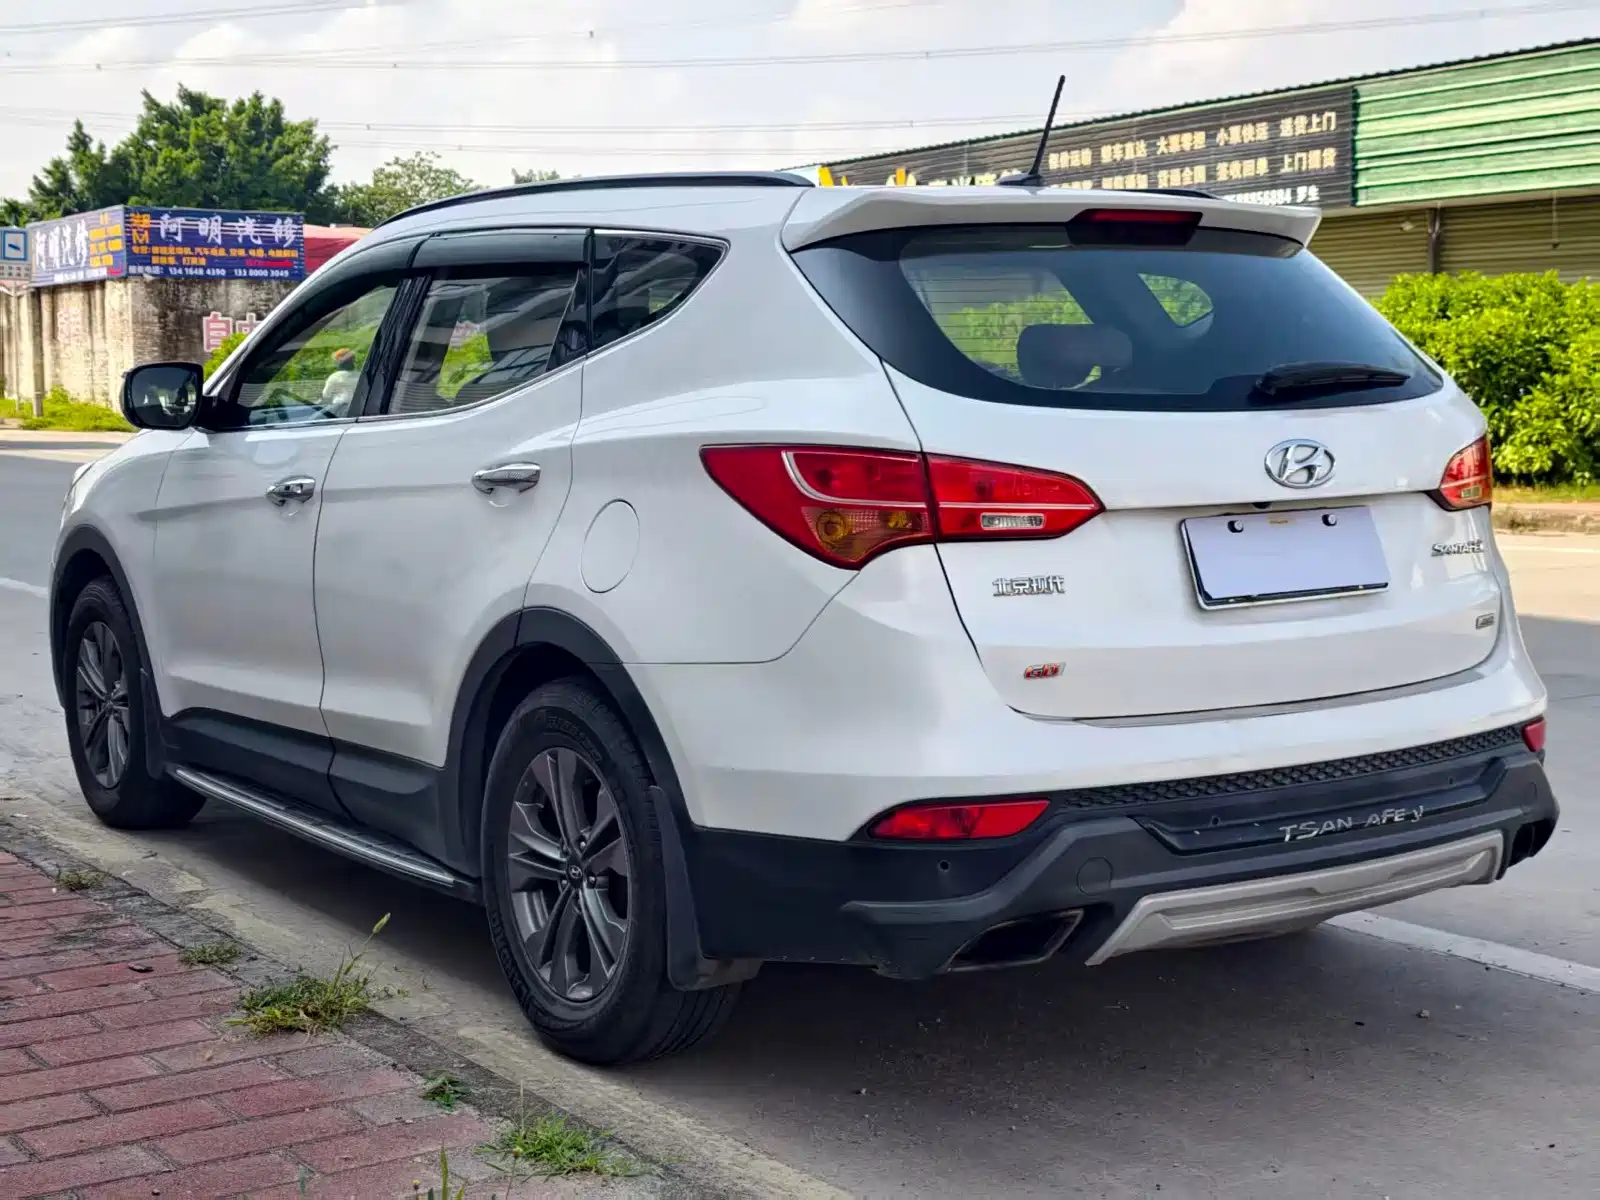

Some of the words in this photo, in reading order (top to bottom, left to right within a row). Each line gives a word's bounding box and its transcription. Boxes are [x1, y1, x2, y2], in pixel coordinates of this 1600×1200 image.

[1279, 111, 1337, 137] 送货上门
[992, 575, 1065, 597] 北京现代
[1279, 816, 1353, 843] TSAN
